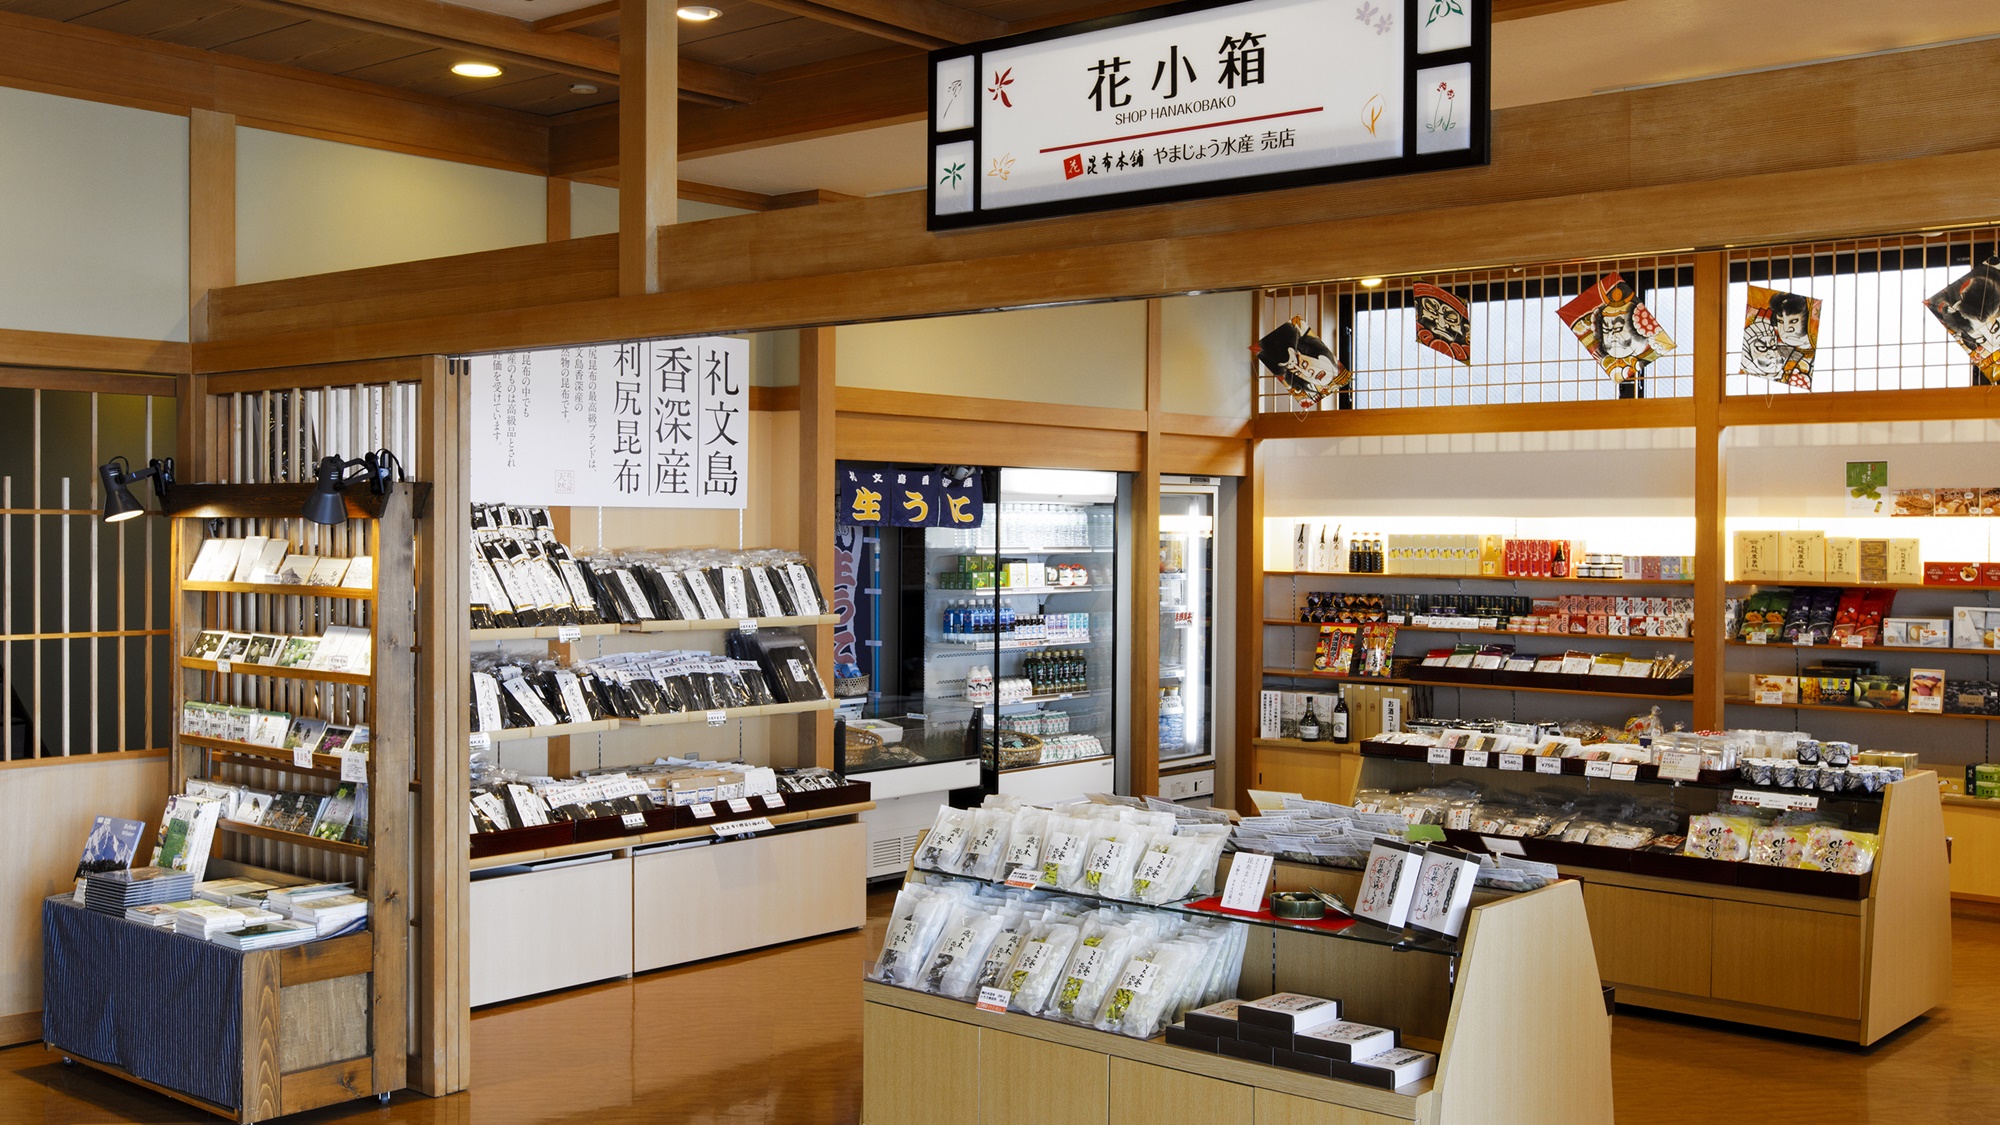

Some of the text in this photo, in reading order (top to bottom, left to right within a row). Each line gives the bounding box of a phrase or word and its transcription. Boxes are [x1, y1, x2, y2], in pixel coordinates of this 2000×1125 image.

[1088, 32, 1267, 112] 花小箱
[1114, 94, 1237, 126] SHOP HANAKOBAKO
[1153, 134, 1255, 165] やまじょう水産
[1261, 128, 1296, 151] 売店
[522, 352, 531, 418] 昆布の中でも
[588, 346, 598, 472] 尻昆布の最高級ブランドは、
[612, 341, 642, 495] 利尻昆布
[654, 345, 693, 496] 香深産
[704, 349, 739, 497] 礼文島
[852, 486, 975, 524] 生うに
